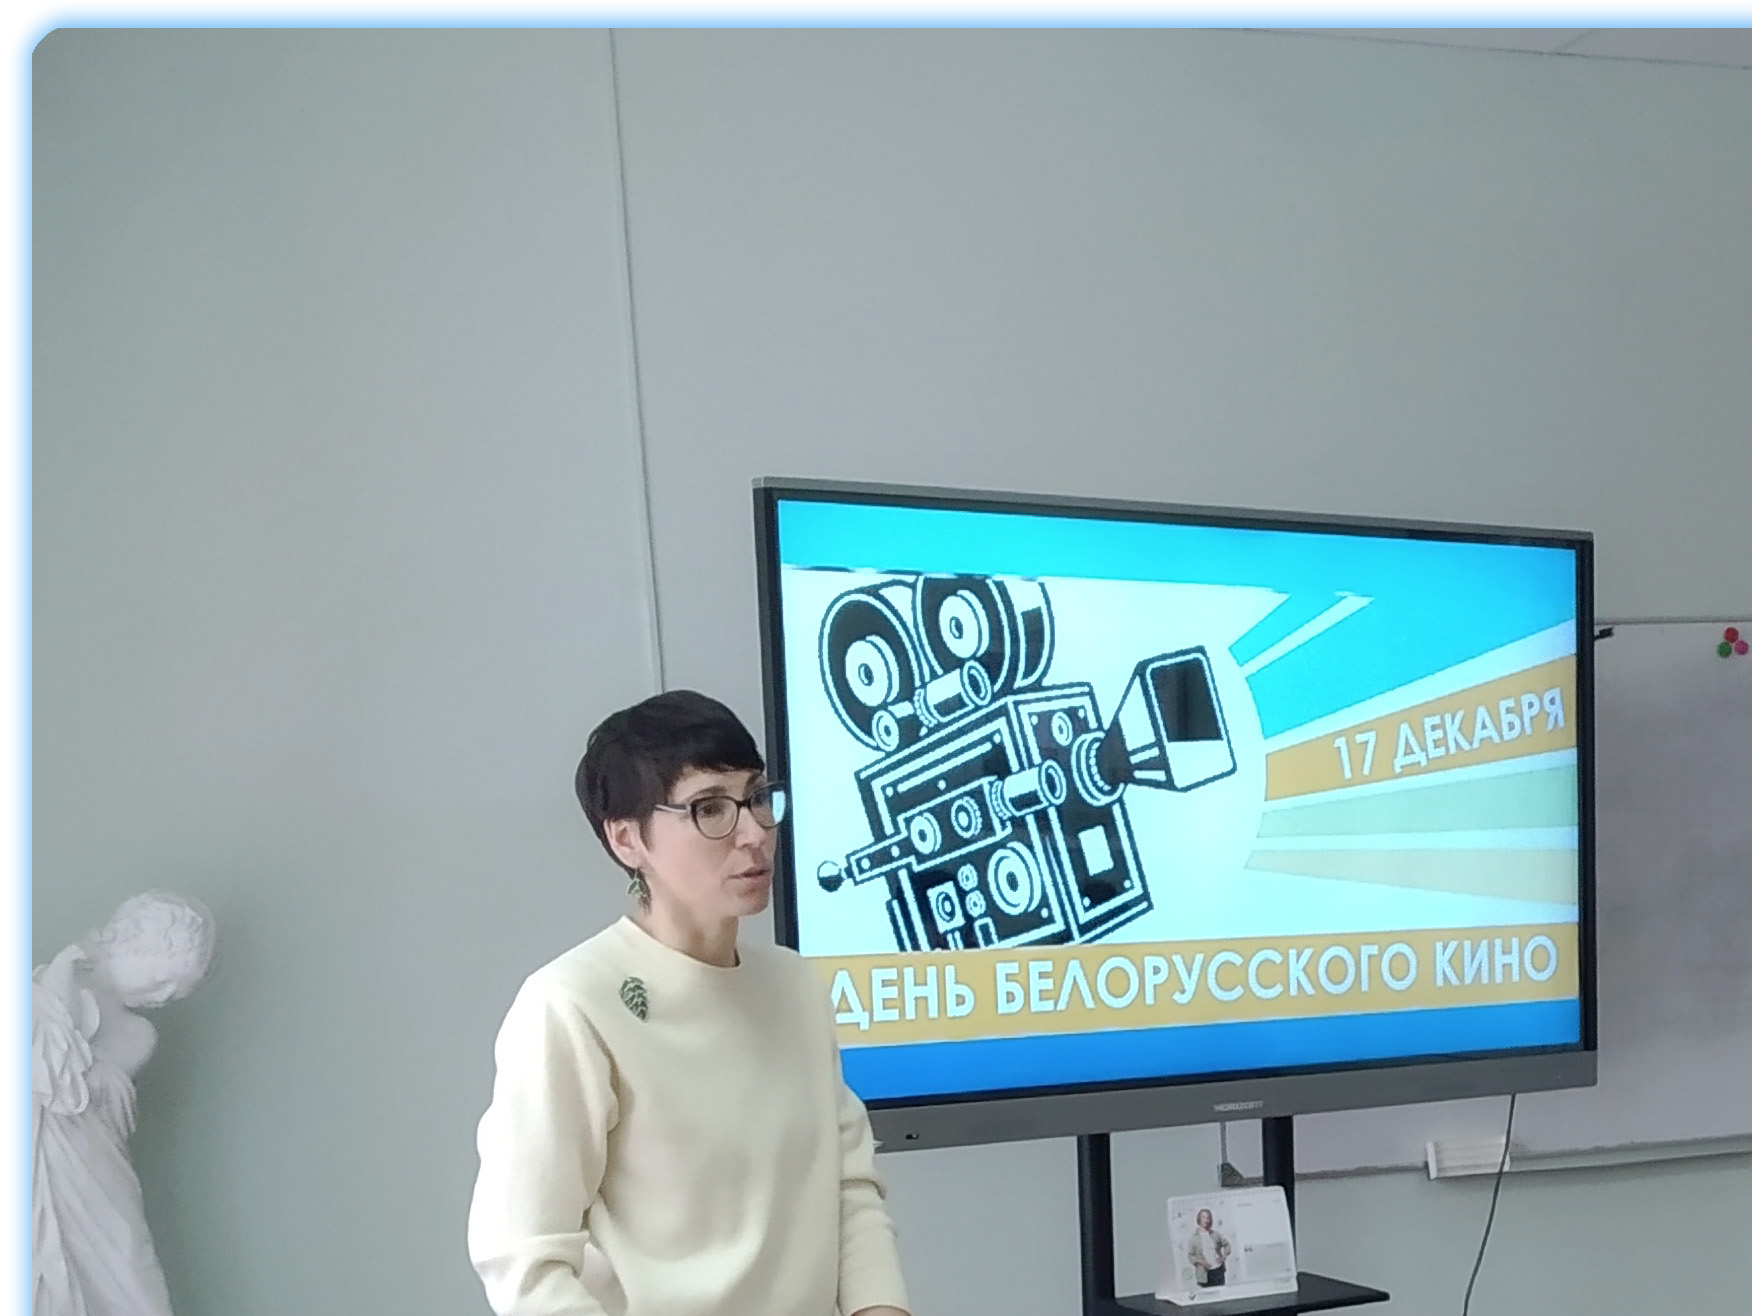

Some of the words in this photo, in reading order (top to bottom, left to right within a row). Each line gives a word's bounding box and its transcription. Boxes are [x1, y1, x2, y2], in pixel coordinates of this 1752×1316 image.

[1333, 731, 1377, 779] 17
[1393, 688, 1565, 773] ДЕКАБРЯ
[831, 964, 976, 1031] ДЕНЬ
[995, 942, 1418, 1016] БЕЛОРУССКОГО
[1435, 935, 1558, 988] КИНО
